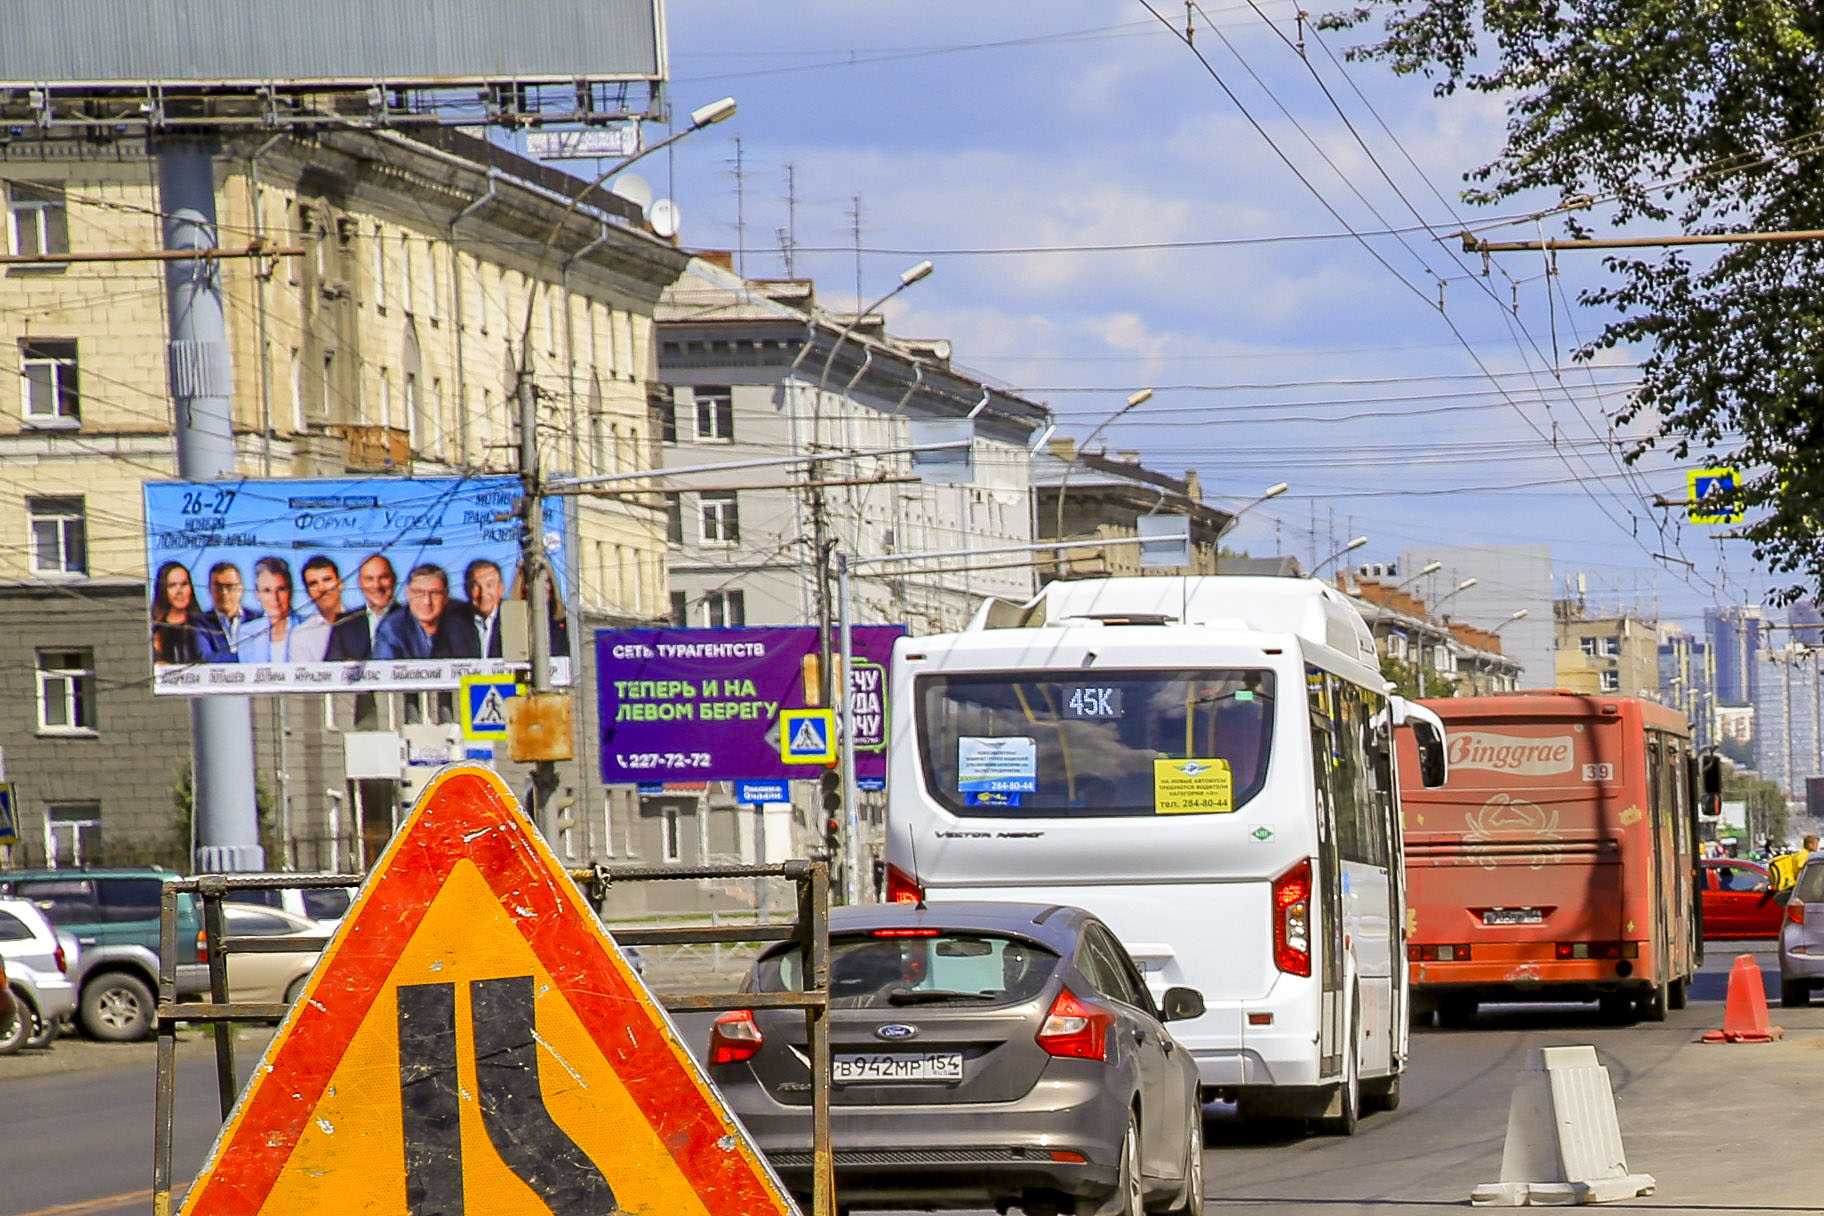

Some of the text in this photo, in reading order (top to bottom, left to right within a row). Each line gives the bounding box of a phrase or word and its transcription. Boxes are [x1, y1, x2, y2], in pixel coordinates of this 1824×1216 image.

[182, 491, 236, 514] 26-27
[612, 642, 765, 659] СЕТЬ ТУРАГЕНТСТВ
[614, 679, 757, 699] ТЕПЕРЬ И НА
[849, 670, 880, 691] ЕЧУ
[615, 701, 779, 721] ЛЕВОМ БЕРЕГУ
[1447, 735, 1569, 768] Binggrae
[629, 753, 712, 769] 227-72-72
[1586, 764, 1609, 779] 39
[991, 781, 1033, 790] 284-80-44
[1183, 799, 1228, 808] 284-80-44
[928, 1054, 959, 1071] 154
